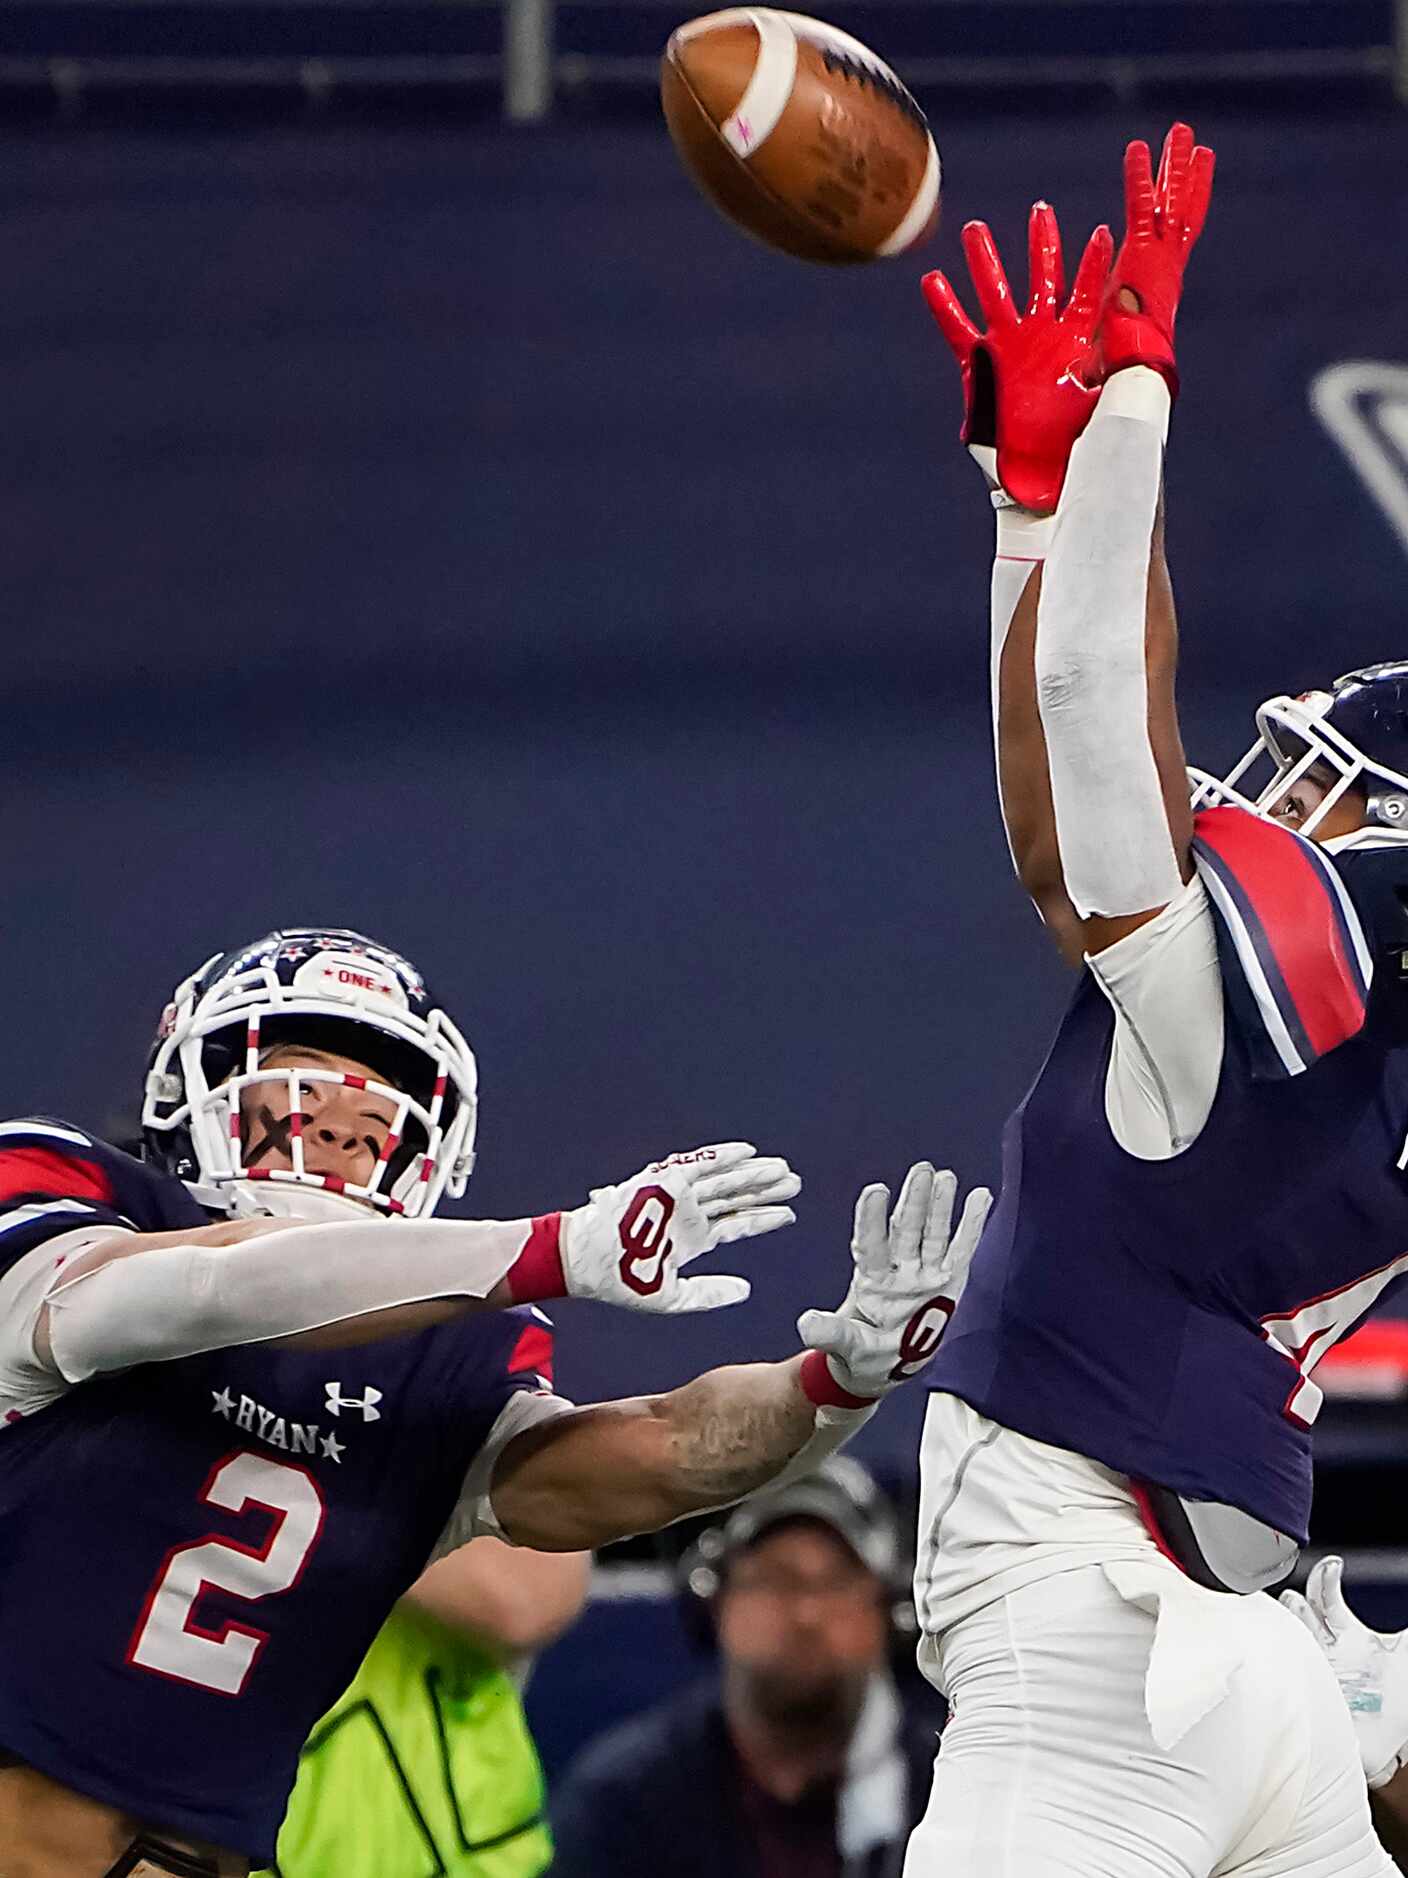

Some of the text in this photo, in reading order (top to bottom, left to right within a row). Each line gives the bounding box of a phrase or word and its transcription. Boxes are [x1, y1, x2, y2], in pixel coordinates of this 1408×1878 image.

[338, 969, 376, 992] ONE
[235, 1393, 320, 1454] RYAN
[125, 1447, 328, 1698] 2
